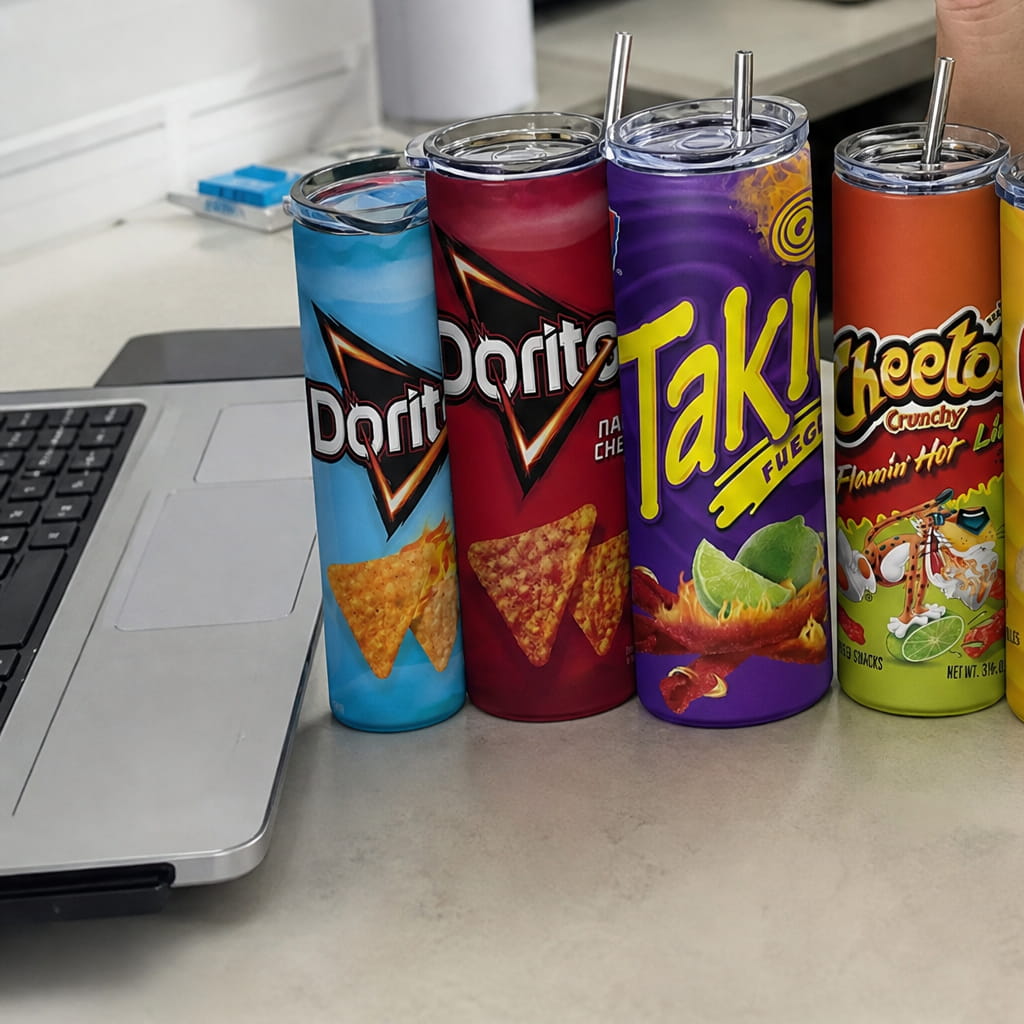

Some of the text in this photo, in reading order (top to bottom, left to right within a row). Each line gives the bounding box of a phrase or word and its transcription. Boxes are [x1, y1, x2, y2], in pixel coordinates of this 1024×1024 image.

[834, 318, 1003, 434] Cheeto
[309, 383, 446, 458] Dorit
[886, 405, 966, 430] Crunchy
[914, 436, 966, 472] Hot
